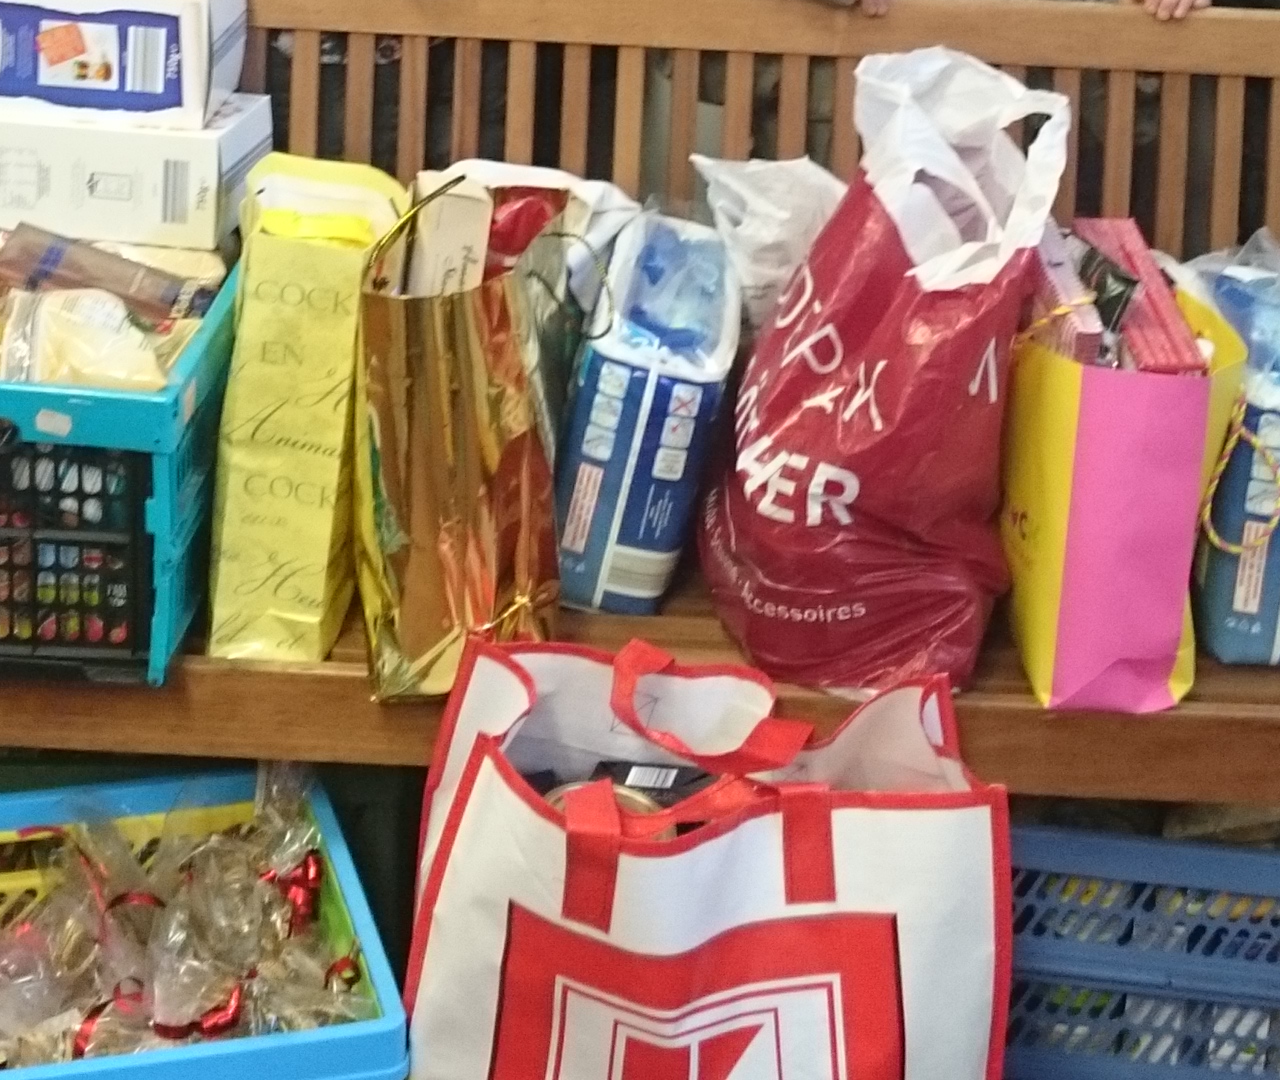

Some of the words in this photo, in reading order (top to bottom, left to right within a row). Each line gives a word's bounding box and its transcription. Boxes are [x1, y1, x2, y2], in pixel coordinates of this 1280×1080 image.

[254, 279, 355, 316] COCK
[261, 340, 303, 366] EN
[243, 473, 336, 509] COCK
